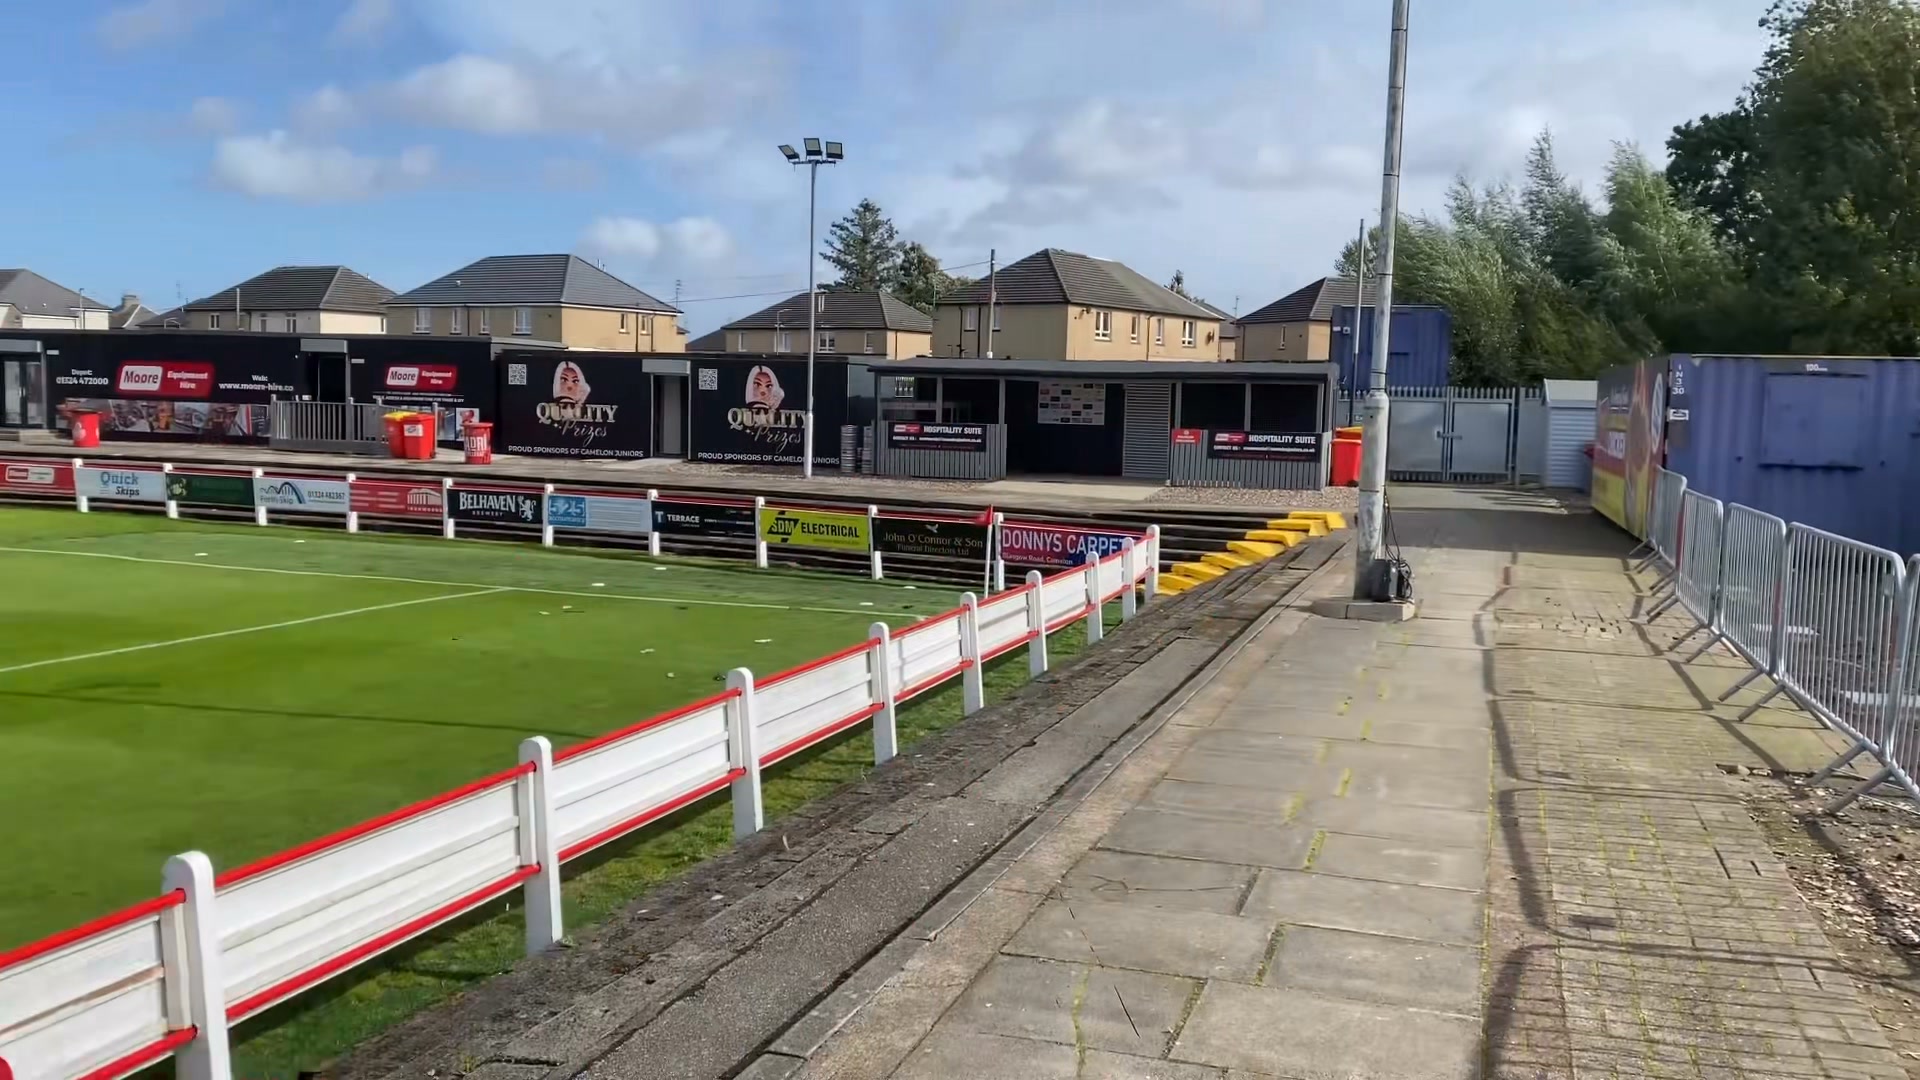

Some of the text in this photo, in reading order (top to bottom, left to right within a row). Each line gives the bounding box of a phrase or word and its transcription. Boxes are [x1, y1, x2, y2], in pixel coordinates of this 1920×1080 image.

[123, 370, 159, 384] Moore
[389, 370, 417, 381] Moore
[535, 402, 619, 425] QUALITY
[561, 418, 608, 448] Prizes
[923, 425, 962, 434] HOSPITALITY
[963, 427, 982, 435] SUITE
[753, 424, 802, 453] Prizes
[1248, 434, 1293, 444] HOSPITALITY
[1294, 435, 1316, 445] SUITE
[508, 445, 533, 453] PROUD
[533, 446, 569, 455] SPONSORS
[580, 448, 614, 456] CAMELON
[615, 450, 644, 458] JUNIORS
[697, 452, 723, 460] PROUD
[723, 453, 762, 461] SPONSORS
[100, 471, 140, 486] Quick
[115, 485, 140, 498] Skips
[459, 491, 516, 513] BELHAVEN
[667, 513, 700, 524] TERRACE
[771, 519, 795, 534] SDM
[801, 521, 860, 539] ELECTRICAL
[883, 531, 906, 543] John
[953, 537, 963, 547] &
[965, 538, 984, 549] Son
[1002, 528, 1062, 553] DONNYS
